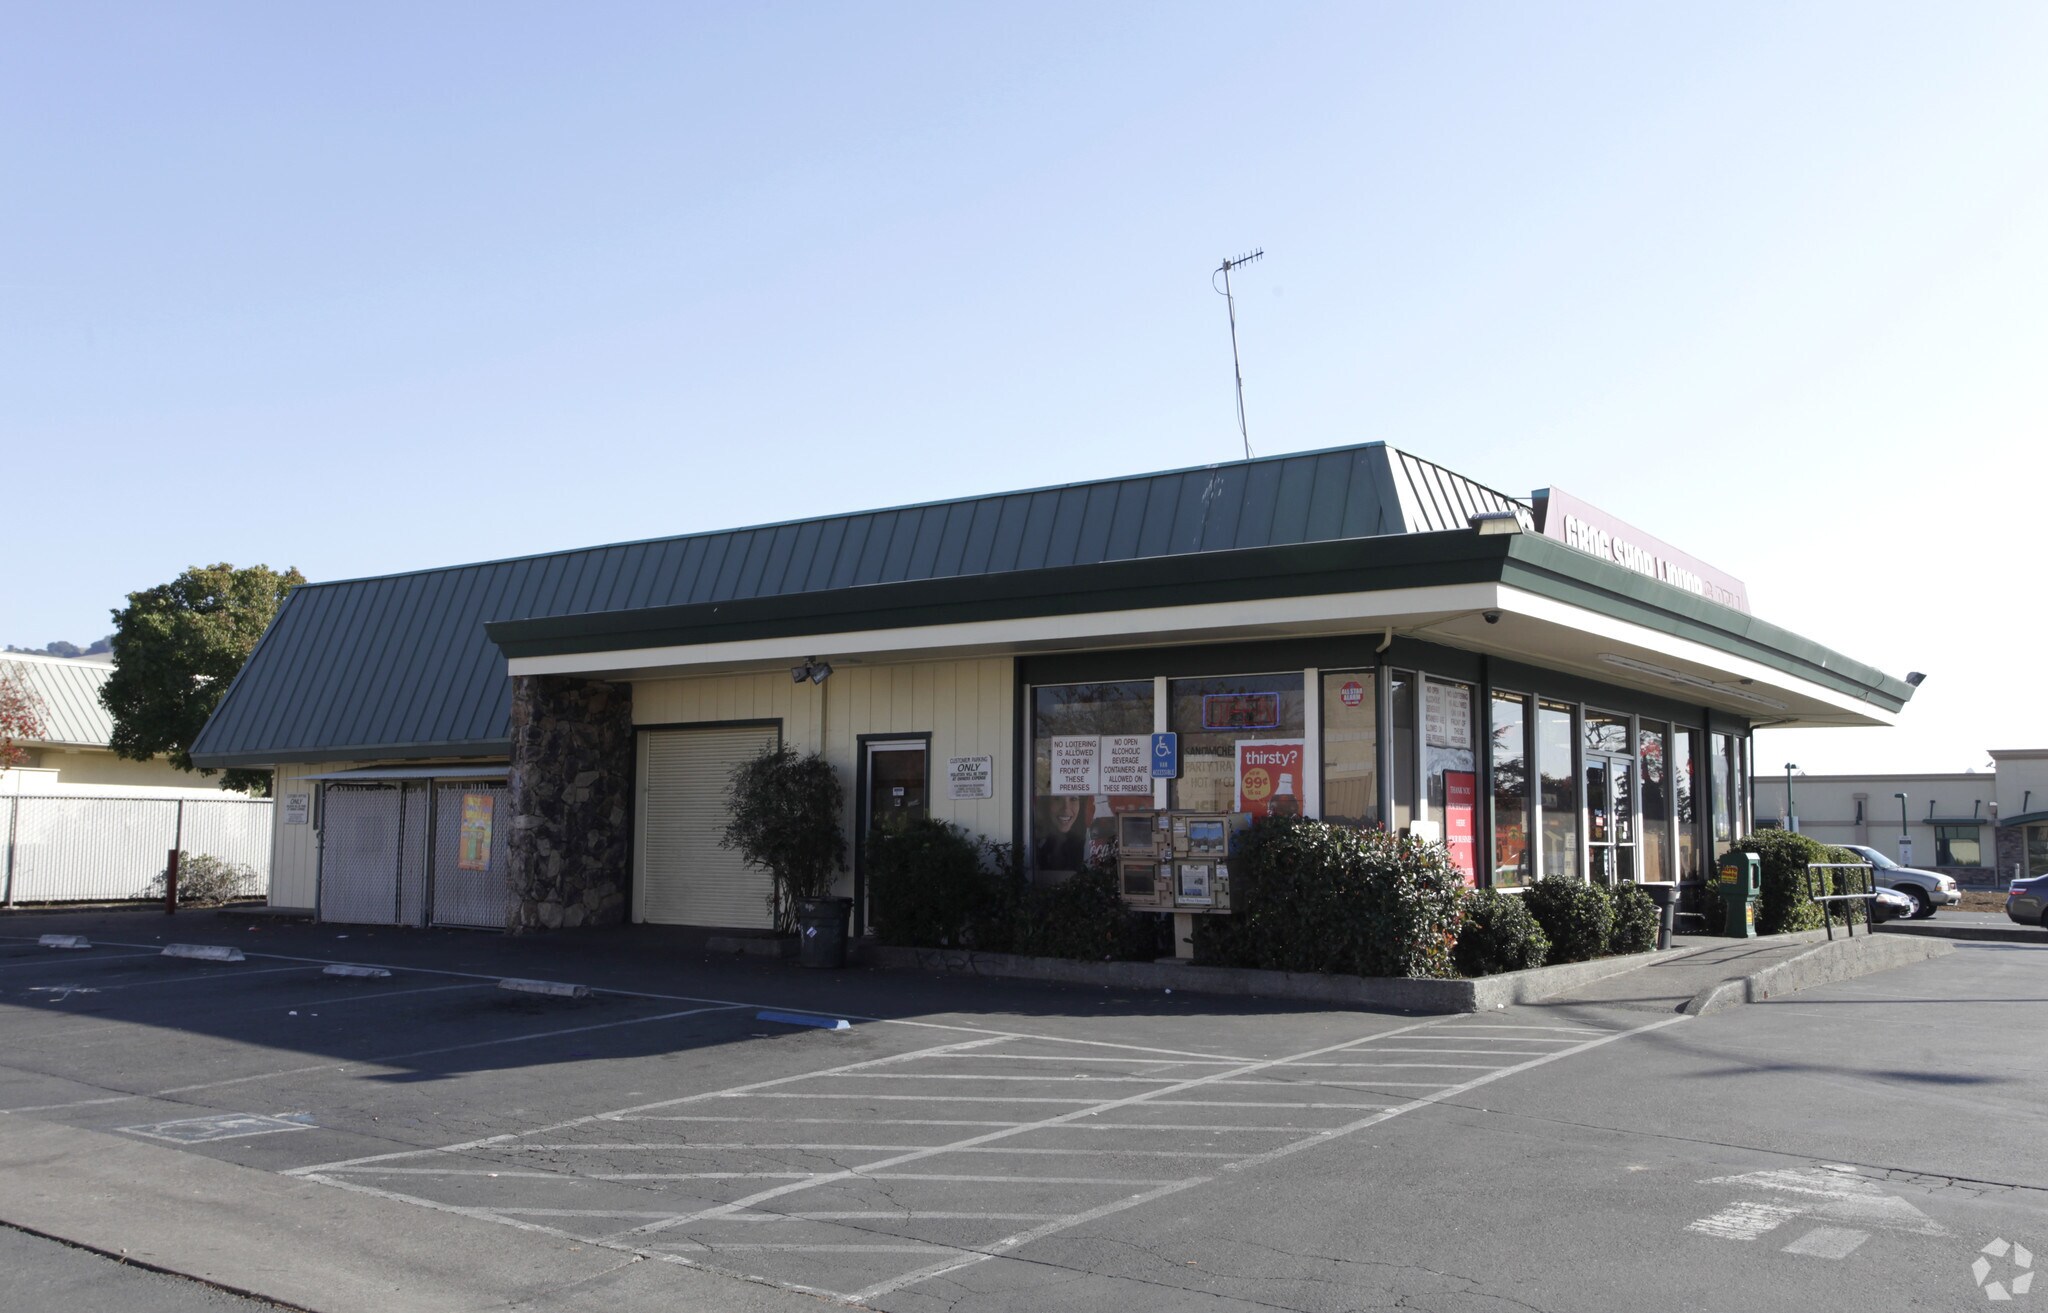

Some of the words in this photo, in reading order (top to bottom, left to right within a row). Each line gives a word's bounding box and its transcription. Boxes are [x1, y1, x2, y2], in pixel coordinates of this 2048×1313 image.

[1564, 514, 1611, 561] GROG
[1611, 536, 1654, 578] SHOP
[1246, 751, 1298, 766] thirsty?
[957, 763, 980, 772] ONLY
[1104, 766, 1136, 774] CONTAINERS
[1109, 775, 1132, 783] ALLOWED
[1245, 777, 1268, 789] 99¢
[1122, 784, 1148, 792] PREMISES
